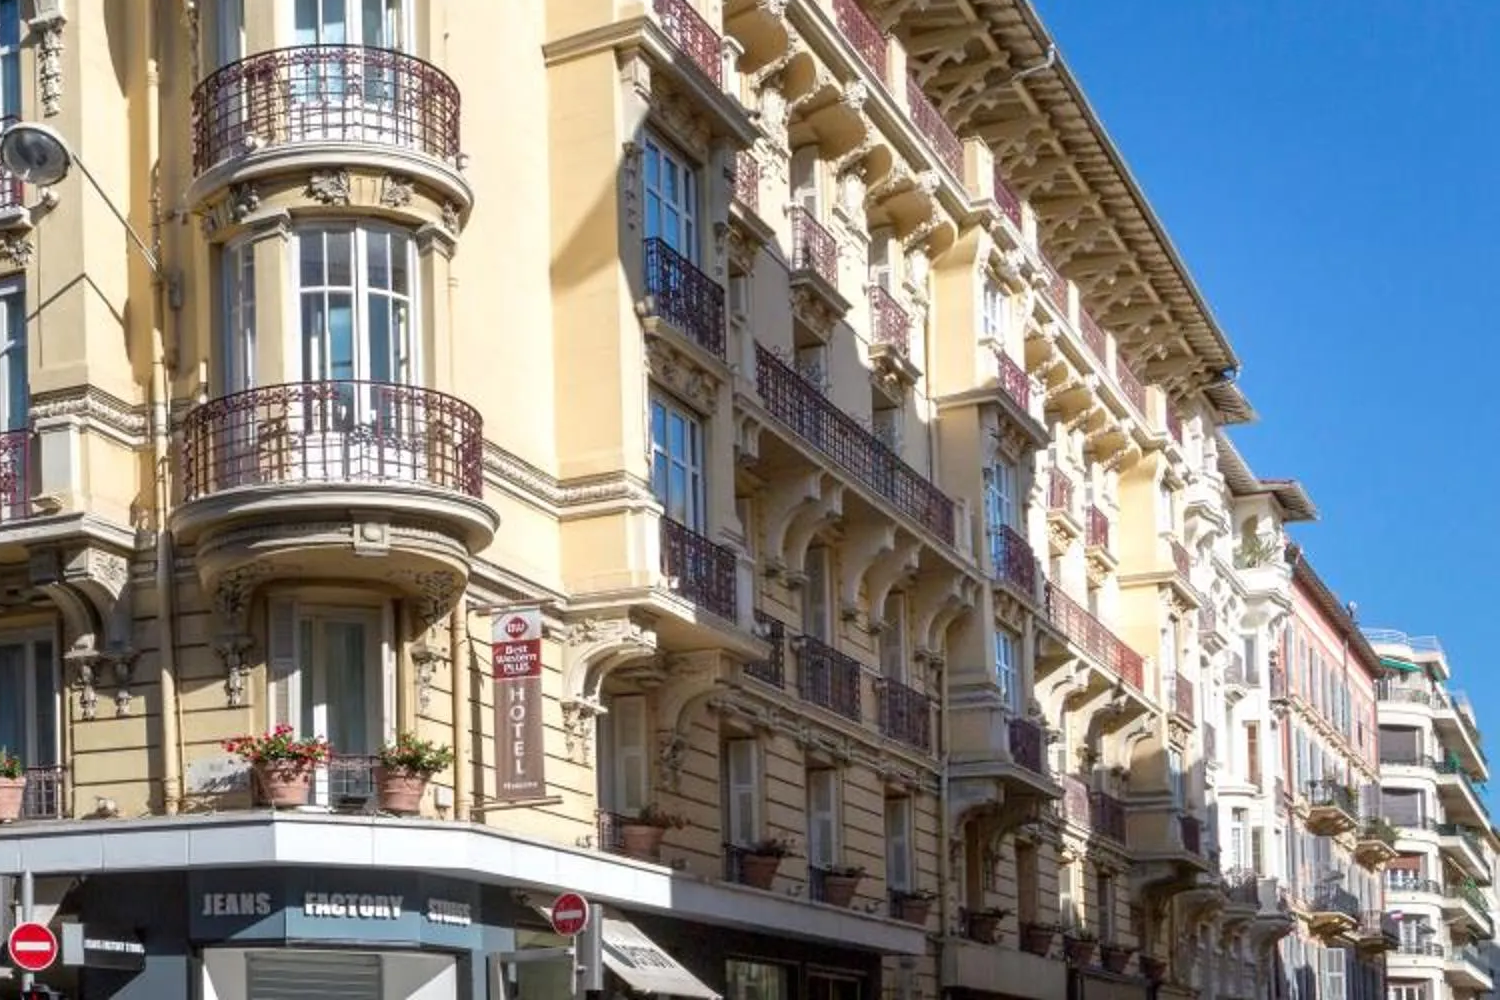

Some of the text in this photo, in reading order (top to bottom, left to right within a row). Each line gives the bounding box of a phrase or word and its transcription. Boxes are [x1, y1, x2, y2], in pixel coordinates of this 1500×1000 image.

[505, 645, 528, 655] Best
[510, 687, 526, 775] HOTEL
[202, 893, 271, 916] JEANS
[304, 892, 404, 919] FACTORY
